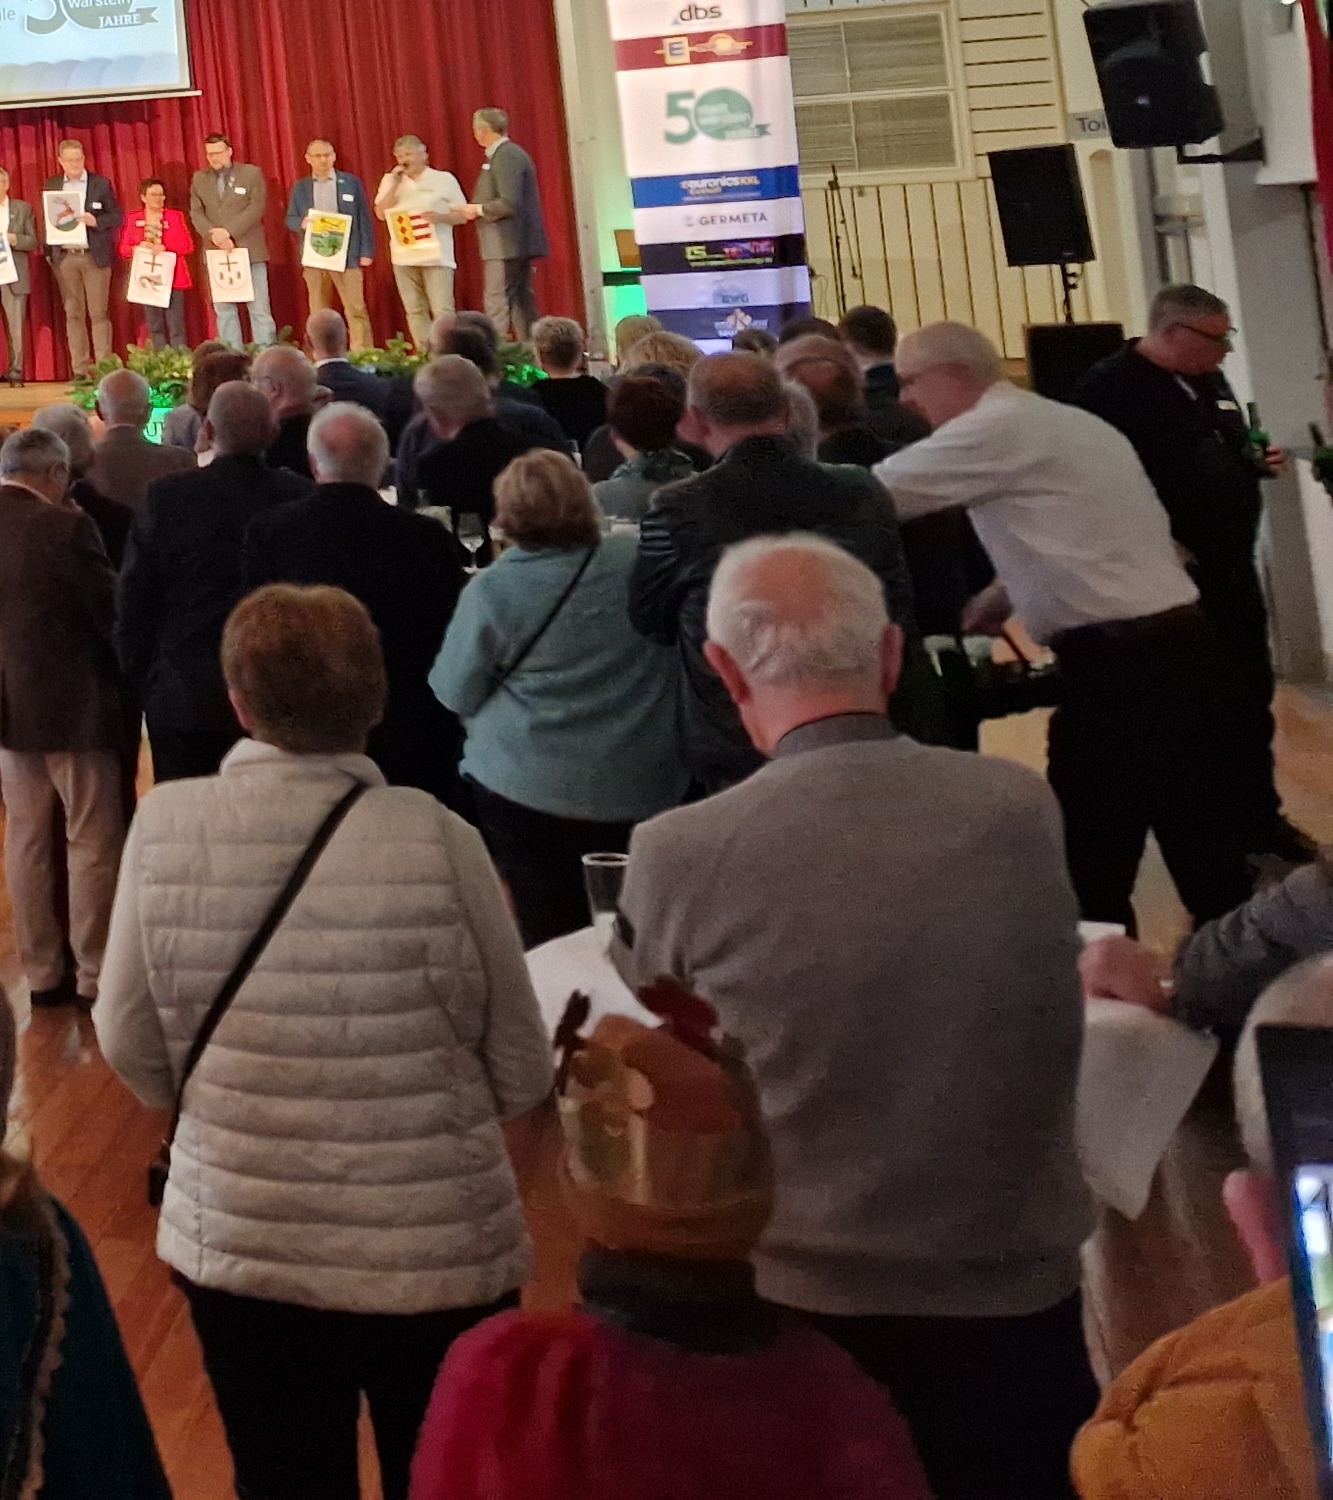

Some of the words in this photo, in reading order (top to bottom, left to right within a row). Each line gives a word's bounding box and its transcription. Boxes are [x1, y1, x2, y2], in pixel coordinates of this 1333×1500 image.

[98, 13, 141, 29] JAHRE
[679, 4, 722, 22] dbs
[699, 213, 768, 225] GERMETA
